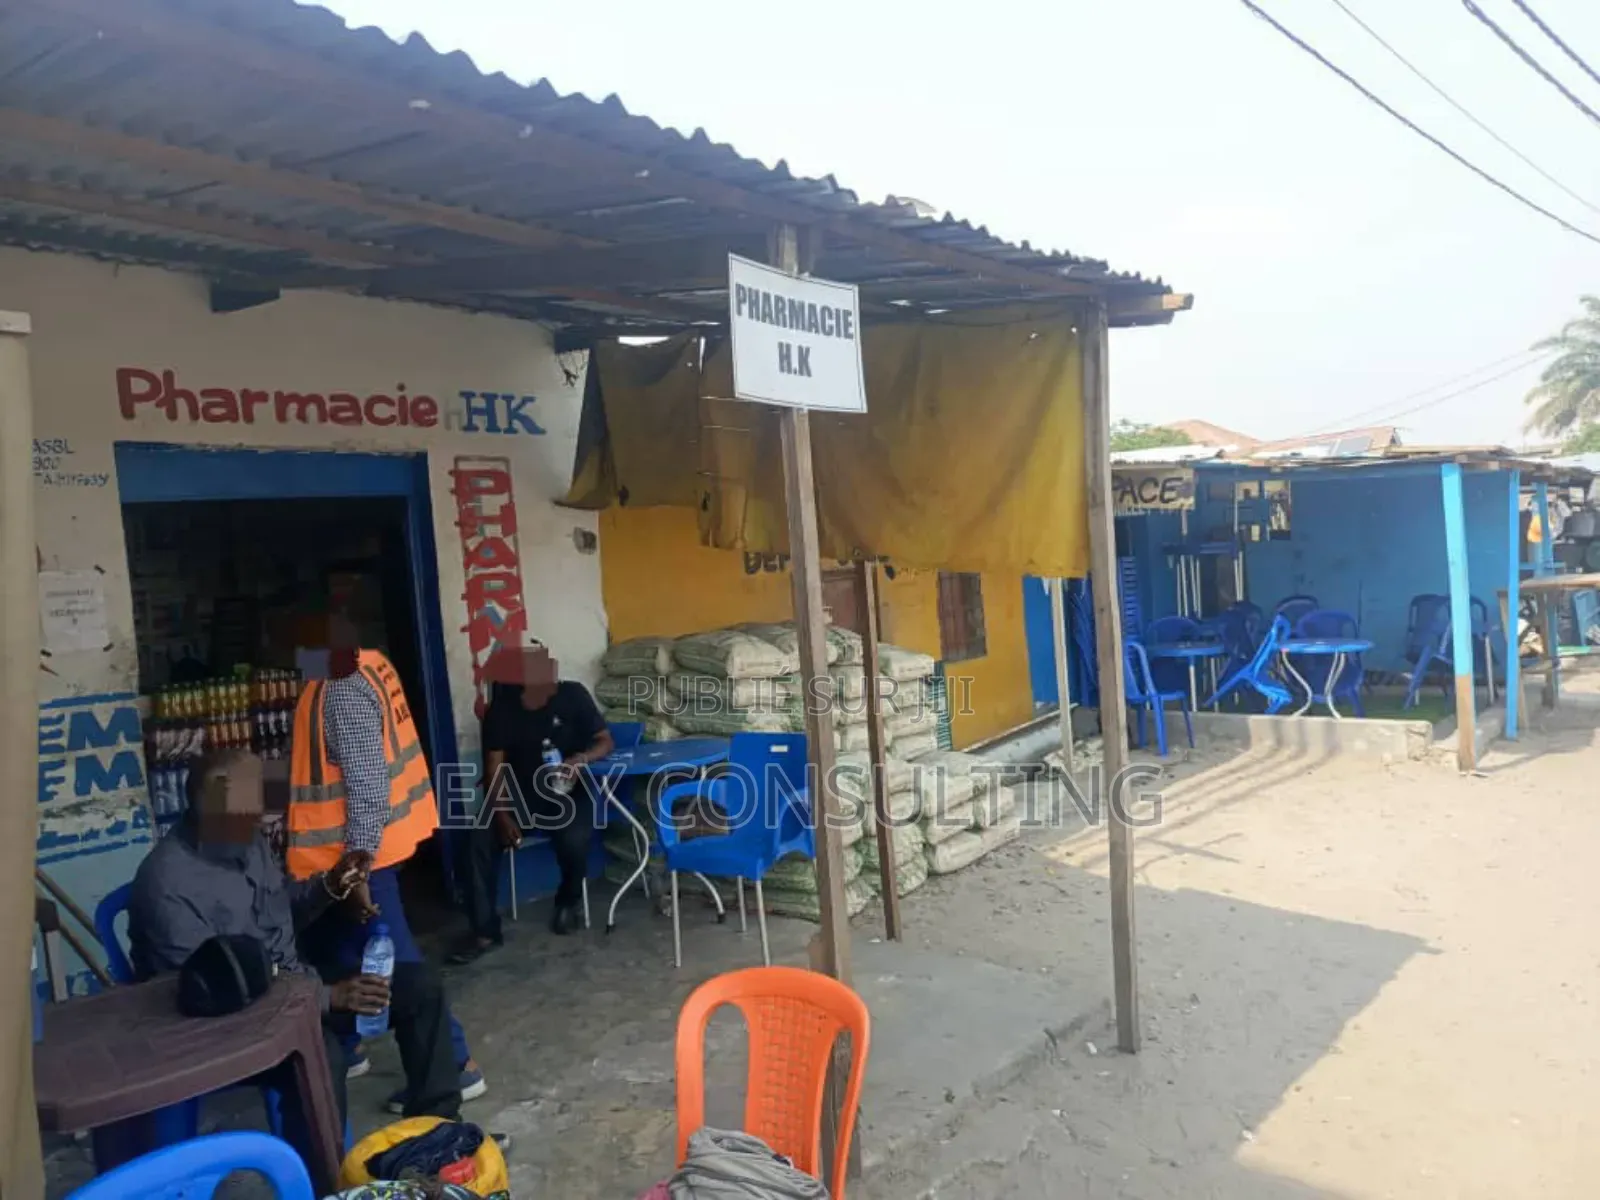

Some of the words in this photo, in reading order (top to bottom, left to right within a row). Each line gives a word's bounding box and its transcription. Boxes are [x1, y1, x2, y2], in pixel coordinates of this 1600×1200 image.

[735, 281, 854, 340] PHARMACIE
[777, 341, 812, 378] H.K
[115, 366, 440, 429] Pharmacie
[459, 390, 547, 436] HK
